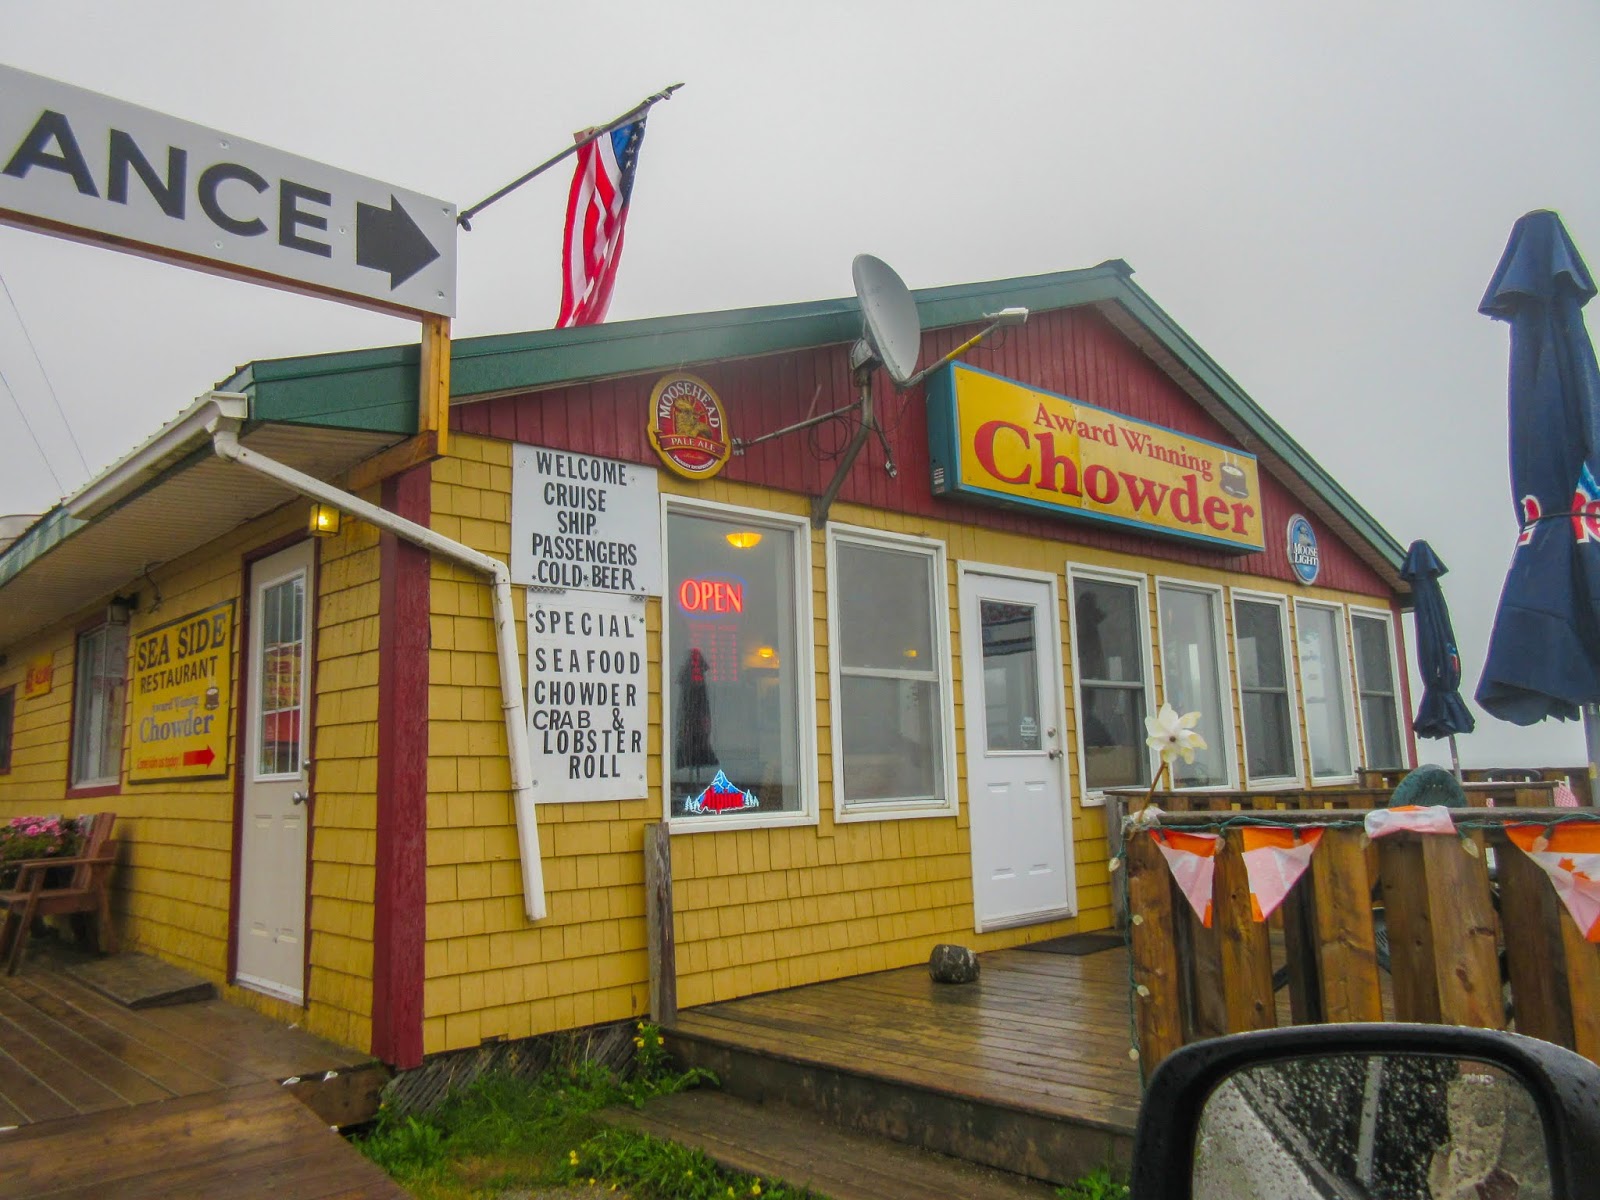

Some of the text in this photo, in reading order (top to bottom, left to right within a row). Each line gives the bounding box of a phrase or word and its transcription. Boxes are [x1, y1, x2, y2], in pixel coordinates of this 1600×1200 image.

[2, 109, 332, 259] ANCE
[659, 382, 720, 428] MOOSEHEAD
[671, 437, 716, 453] PALE ALE
[1033, 402, 1213, 482] Award Winning
[536, 451, 627, 486] WELCOME
[973, 420, 1255, 536] Chowder
[544, 482, 607, 512] CRUISE
[557, 510, 597, 535] SHIP
[532, 532, 637, 566] PASSENGERS
[1293, 542, 1319, 558] MOOSE
[1294, 553, 1319, 566] LIGHT
[538, 560, 636, 591] COLD BEER
[680, 579, 743, 613] OPEN
[535, 609, 635, 638] SPECIAL
[137, 613, 227, 672] SEA SIDE
[140, 655, 218, 695] RESTAURANT
[535, 647, 640, 675] SEAFOOD
[534, 680, 637, 707] CHOWDER
[140, 708, 215, 743] Chowder
[533, 707, 625, 731] CRAB &
[543, 729, 642, 755] LOBSTER
[569, 754, 621, 780] ROLL
